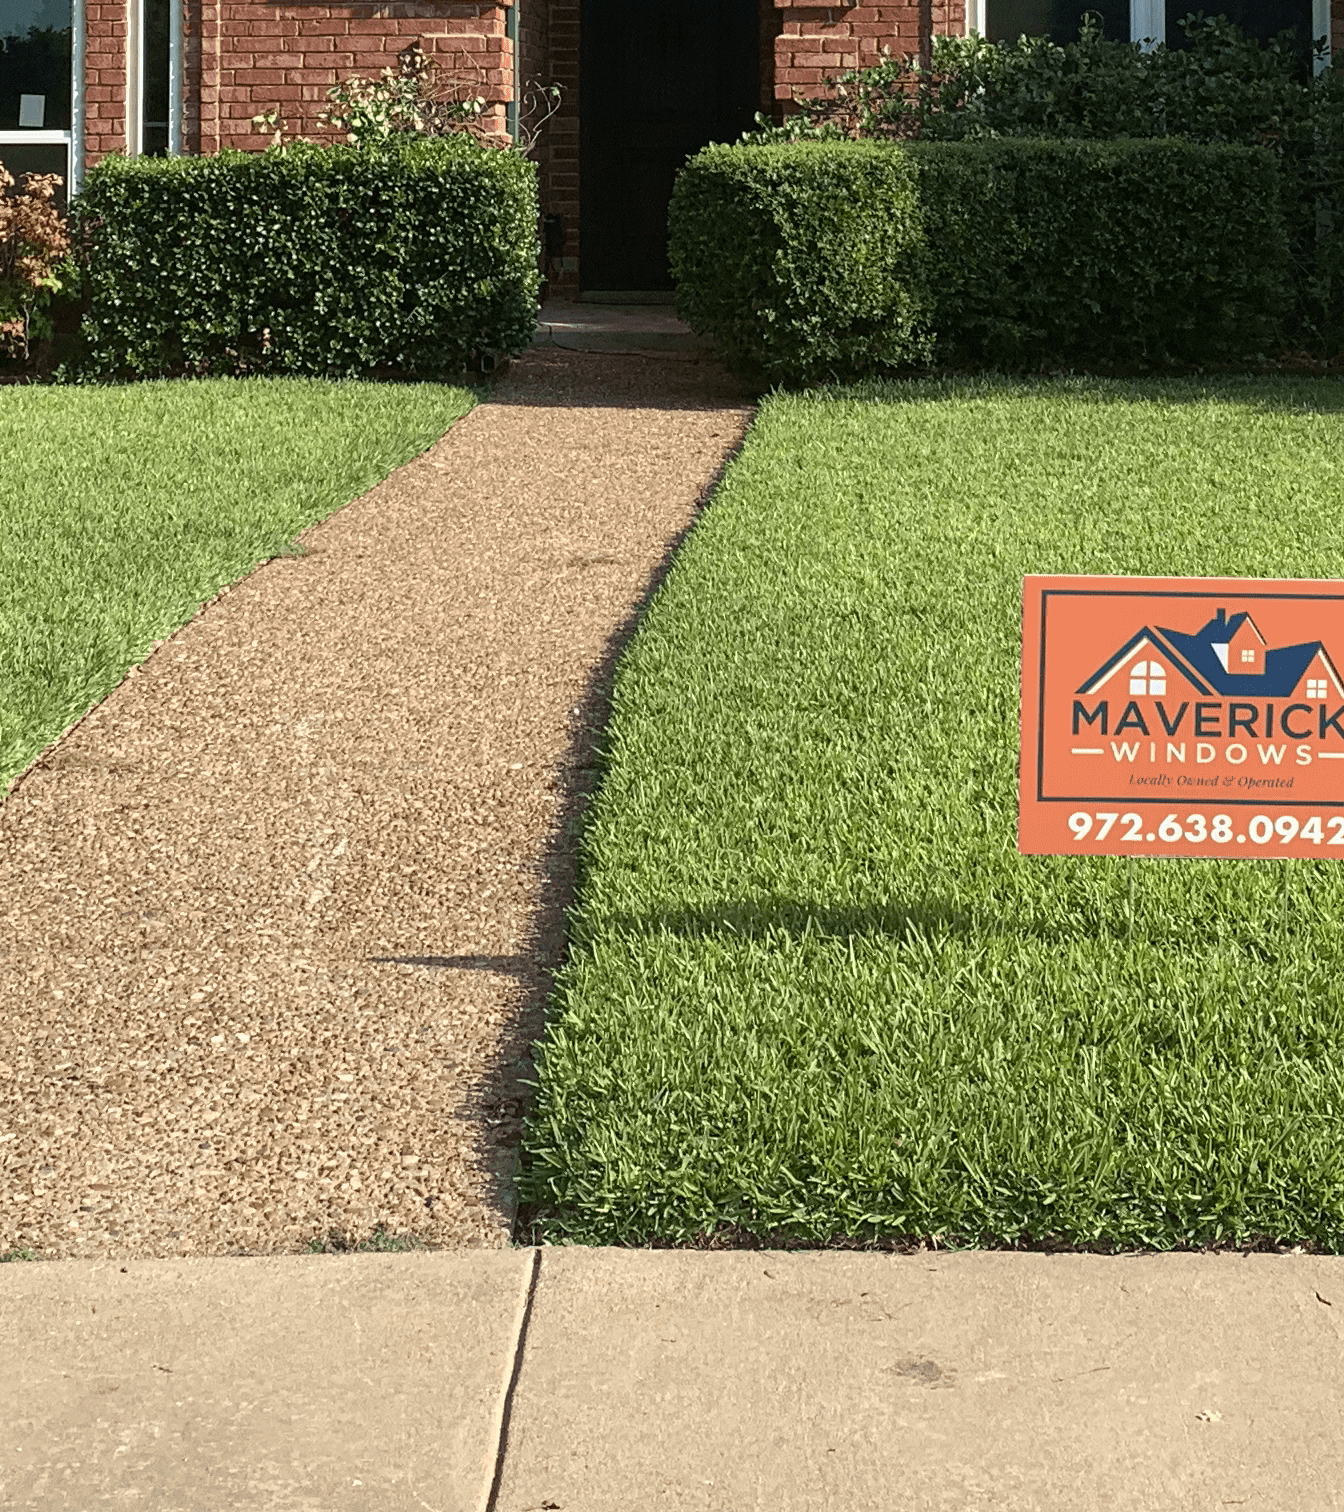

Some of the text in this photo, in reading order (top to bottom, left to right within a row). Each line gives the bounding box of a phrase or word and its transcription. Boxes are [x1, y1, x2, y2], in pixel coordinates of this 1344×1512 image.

[1110, 741, 1313, 766] WINDOWS
[1129, 773, 1295, 790] Locally Owned & Operated
